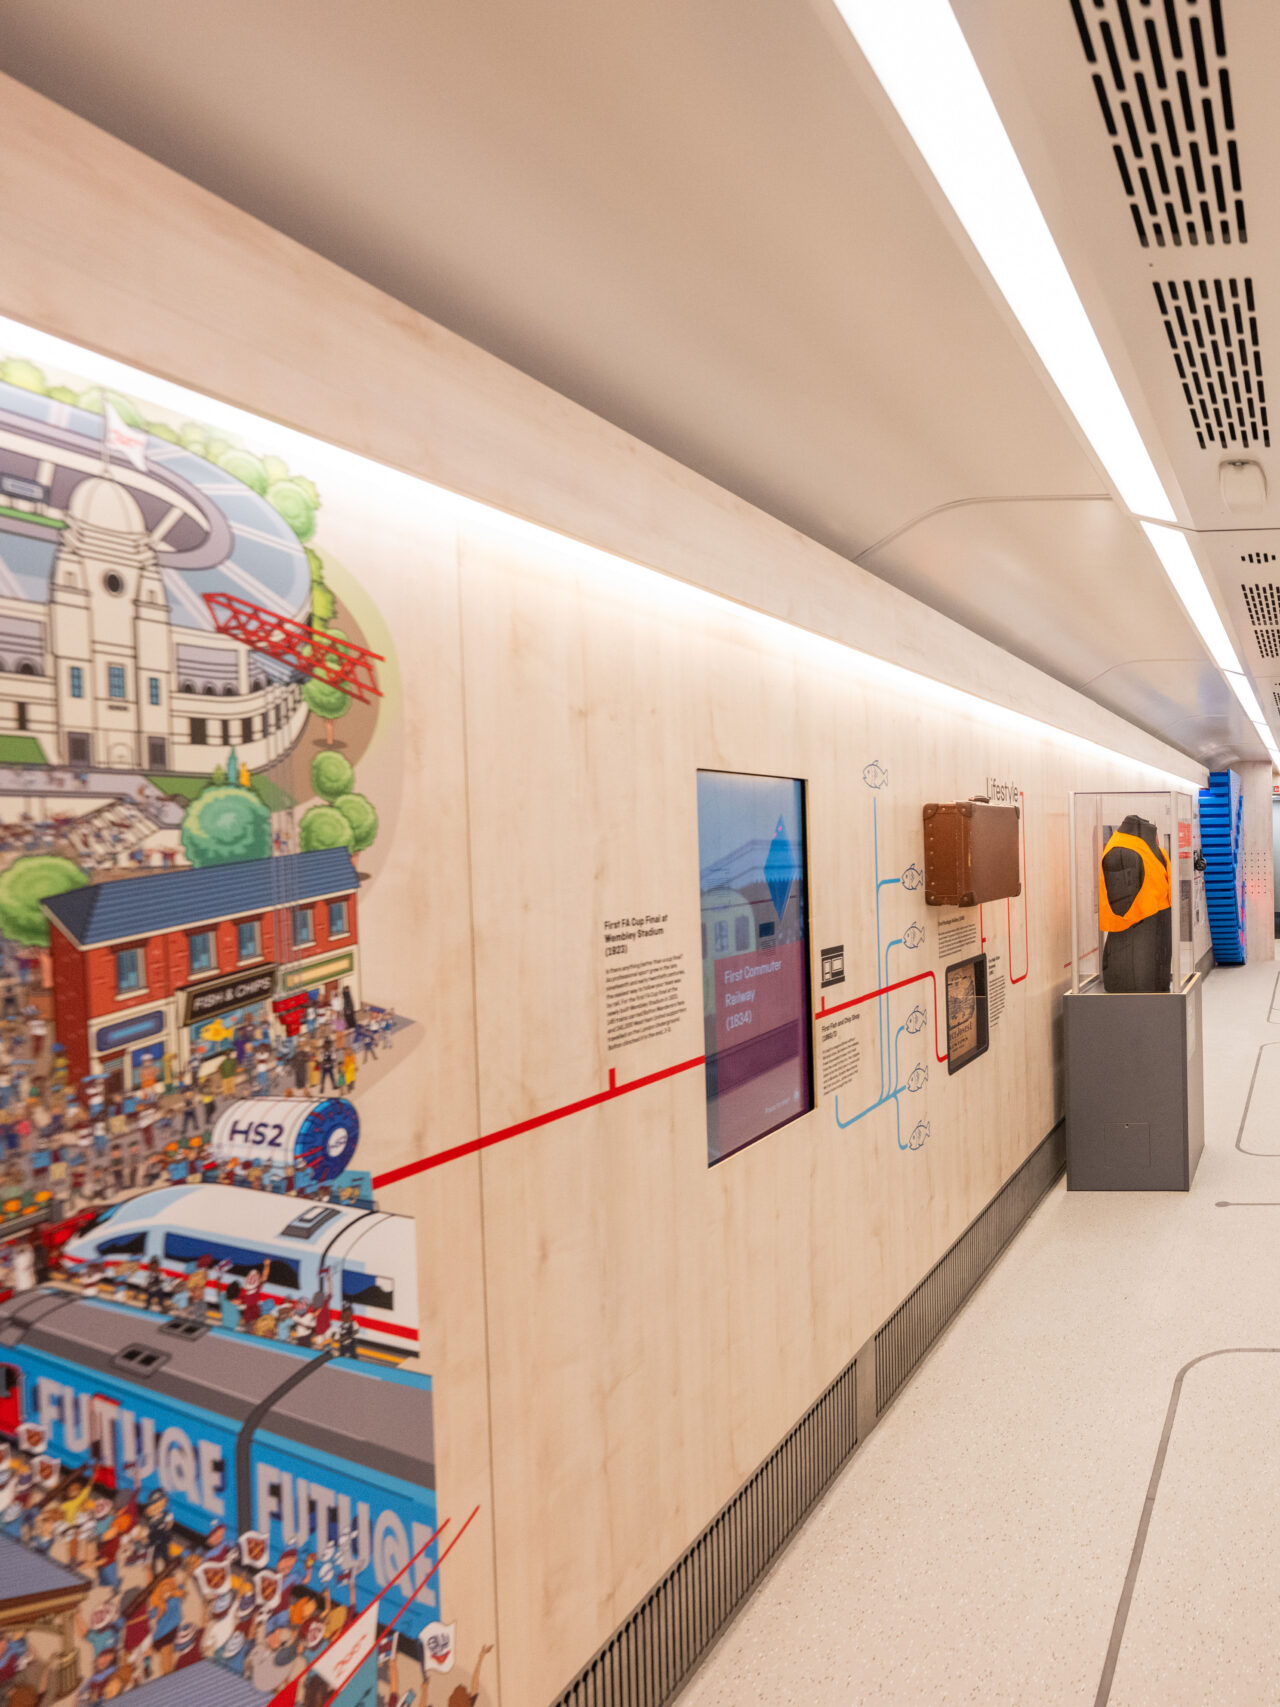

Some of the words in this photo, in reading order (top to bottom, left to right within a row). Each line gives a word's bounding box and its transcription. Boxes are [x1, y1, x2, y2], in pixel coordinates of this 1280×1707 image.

[986, 777, 1018, 804] Lifestyle
[604, 919, 621, 931] First
[631, 917, 645, 929] Cup
[645, 914, 661, 926] Final
[604, 931, 637, 943] Wembley
[637, 928, 664, 939] Stadium
[723, 967, 743, 985] First
[744, 960, 782, 980] Commuter
[193, 990, 224, 1011] FISH
[234, 976, 272, 999] CHIPS
[725, 989, 756, 1008] Railway
[726, 1010, 752, 1032] (1834)
[229, 1120, 284, 1148] HS2
